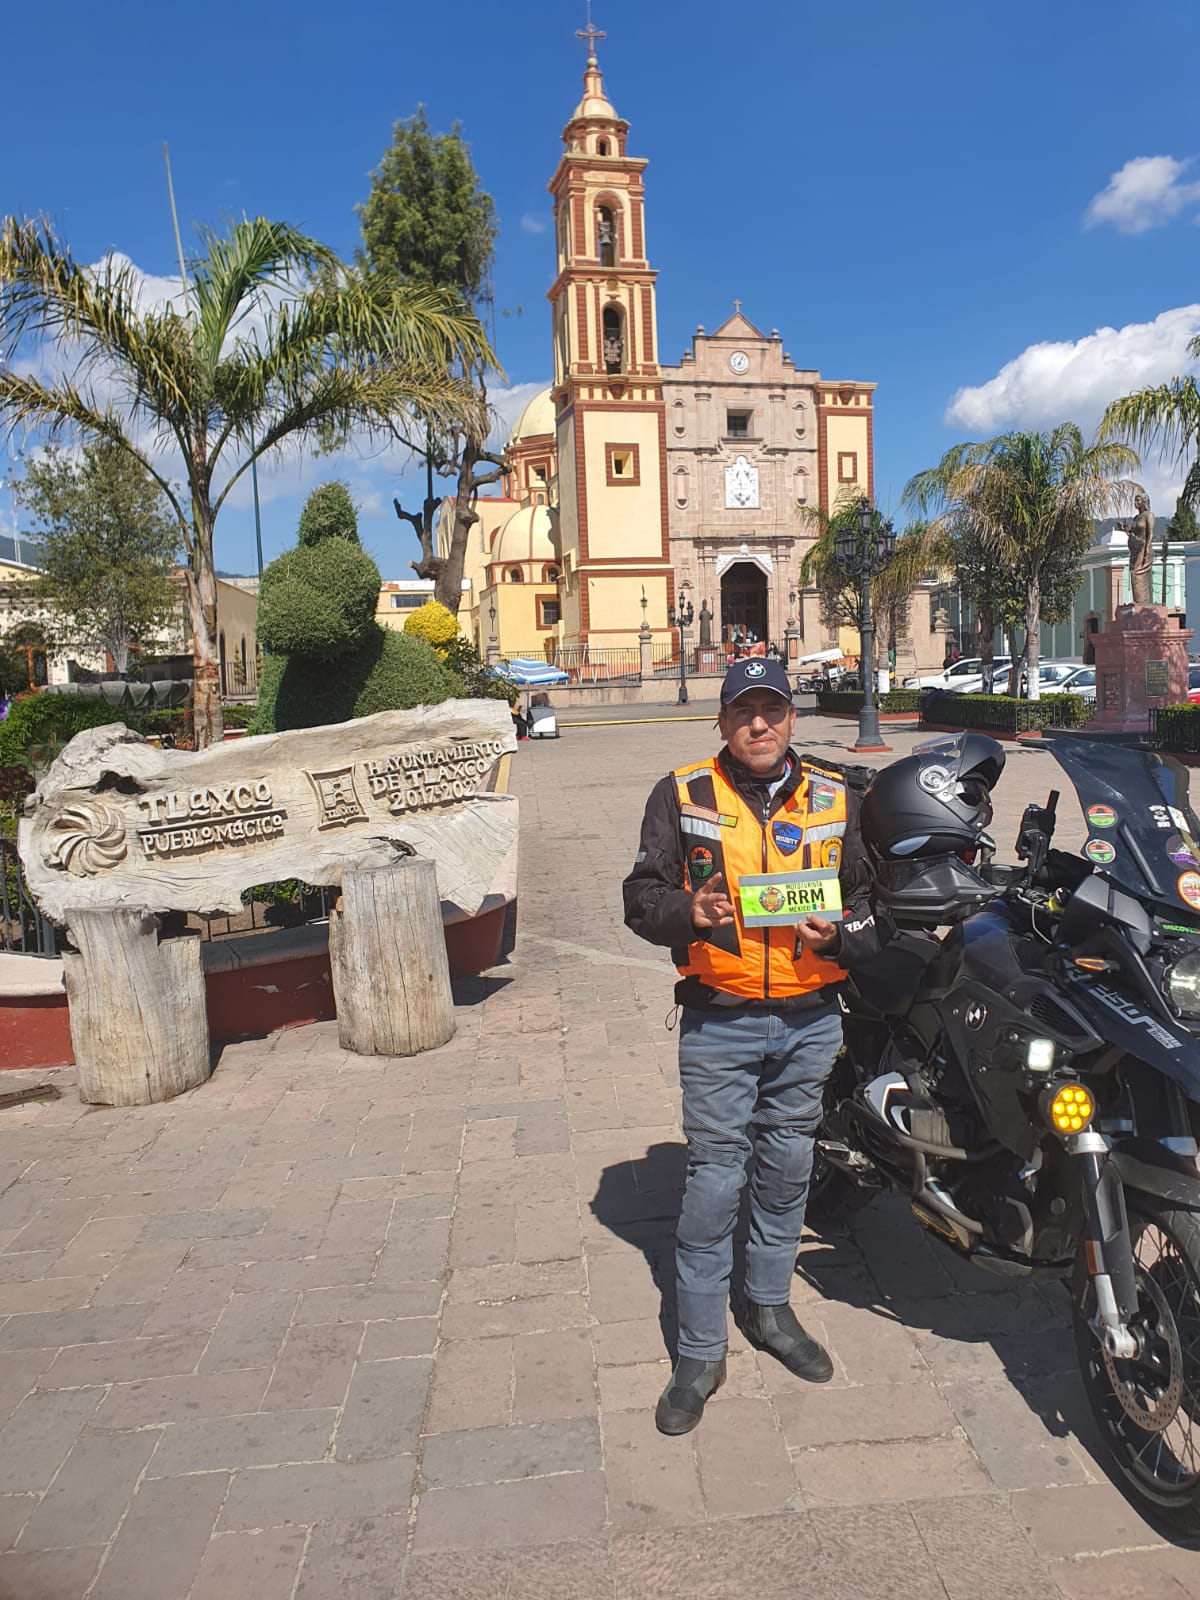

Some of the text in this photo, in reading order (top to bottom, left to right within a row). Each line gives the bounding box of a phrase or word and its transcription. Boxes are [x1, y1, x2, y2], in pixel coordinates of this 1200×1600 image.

[386, 741, 502, 769] AYUNTAMIENTO
[370, 759, 487, 795] DE TLAXCO
[786, 880, 823, 890] MOTOTURISTA
[787, 888, 825, 906] RRM
